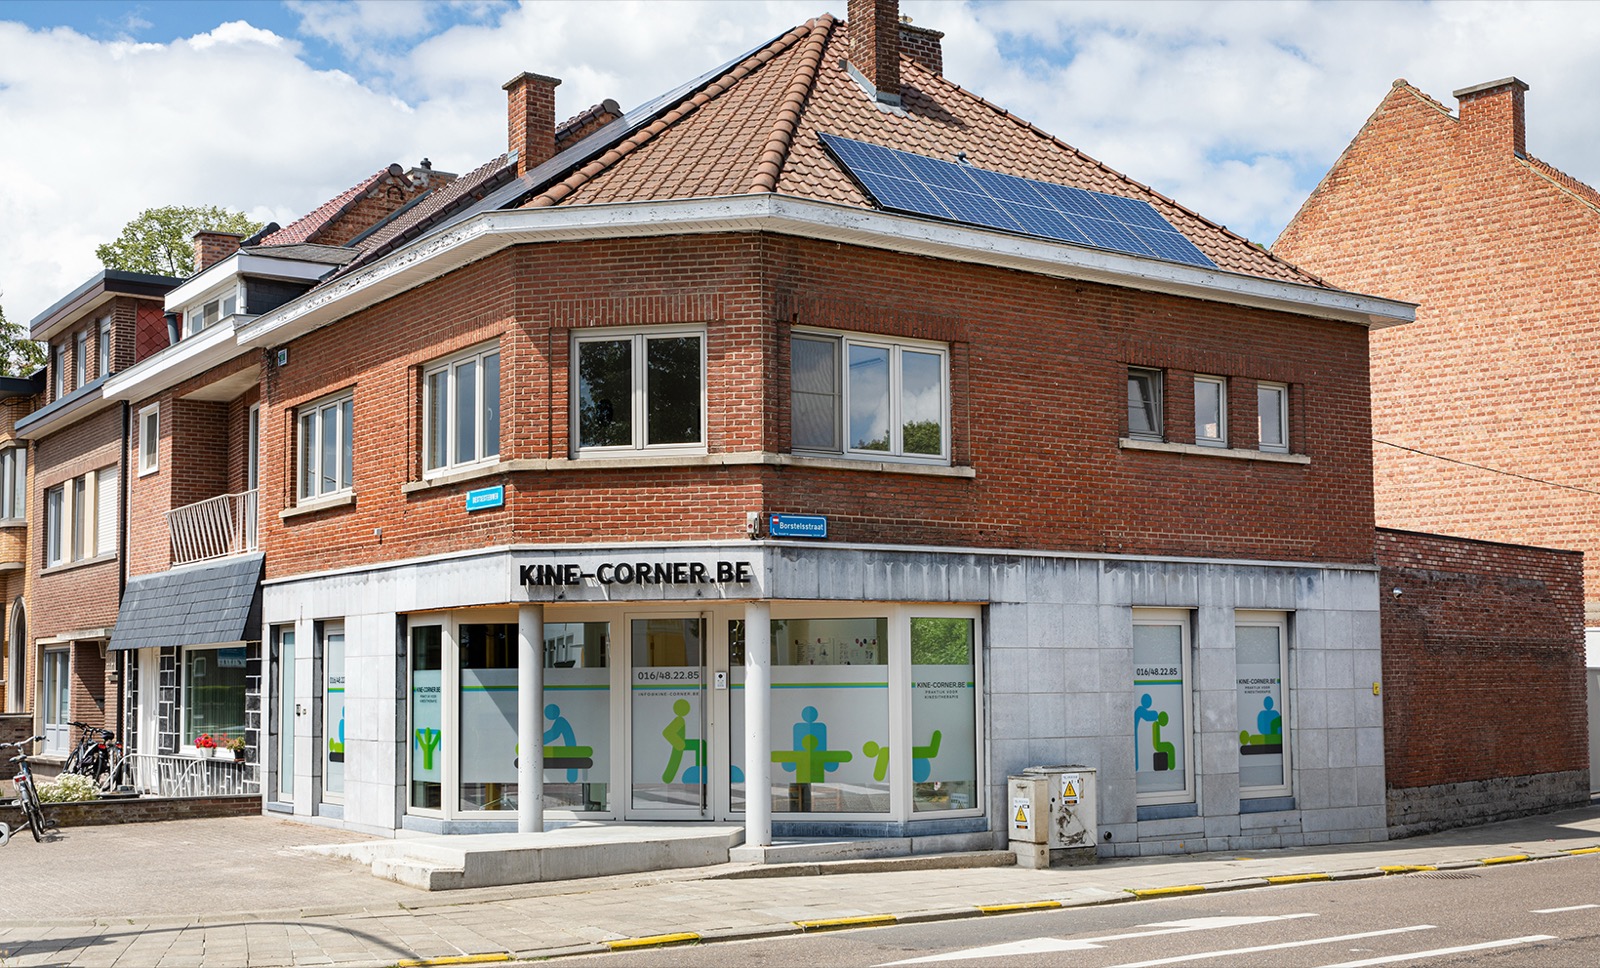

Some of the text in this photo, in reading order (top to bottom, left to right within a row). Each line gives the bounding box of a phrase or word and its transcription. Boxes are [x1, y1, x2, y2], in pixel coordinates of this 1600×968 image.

[779, 521, 824, 531] Borstelsstraat
[519, 561, 751, 586] KINE-CORNER.BE
[637, 671, 699, 680] 016/48.22.85
[1136, 667, 1178, 676] 016/48.22.85
